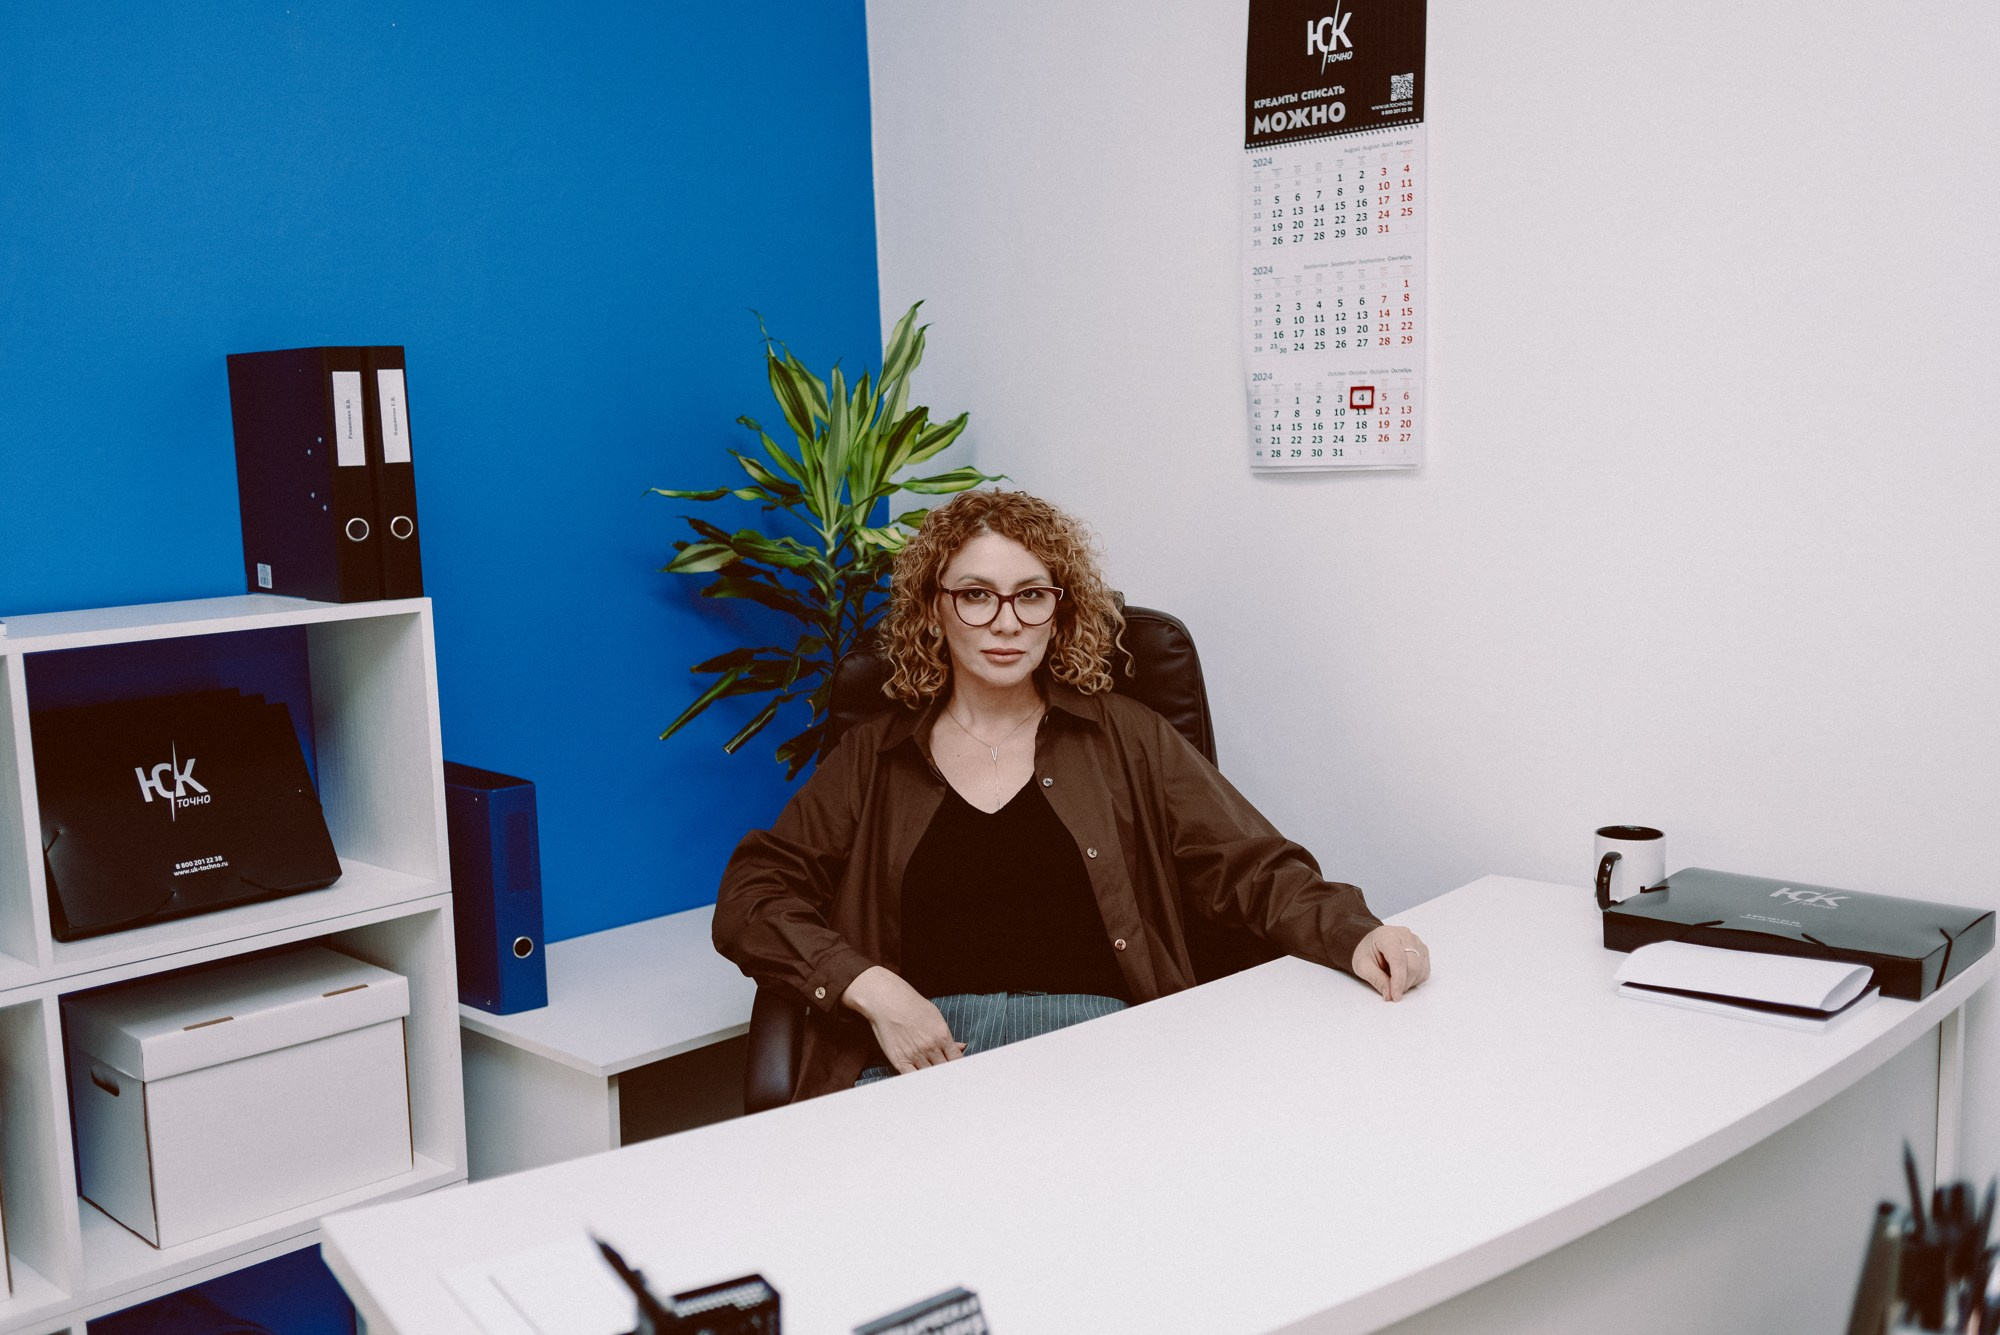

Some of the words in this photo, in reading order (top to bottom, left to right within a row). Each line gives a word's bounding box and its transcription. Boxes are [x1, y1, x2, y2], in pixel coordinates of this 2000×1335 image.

[1254, 93, 1298, 109] КРЕДИТЫ
[1301, 86, 1345, 101] СПИСАТЬ
[1253, 102, 1346, 135] МОЖНО
[1253, 158, 1273, 168] 2024
[1338, 174, 1342, 182] 1
[1360, 170, 1364, 179] 2
[1381, 168, 1386, 176] 3
[1404, 164, 1410, 172] 4
[1275, 196, 1280, 204] 5
[1295, 193, 1300, 201] 6
[1316, 190, 1322, 198] 7
[1337, 188, 1342, 196] 8
[1359, 185, 1364, 193] 9
[1378, 182, 1390, 190] 10
[1402, 179, 1412, 188] 11
[1272, 209, 1282, 218] 12
[1293, 207, 1303, 215] 13
[1314, 204, 1324, 213] 14
[1336, 201, 1346, 210] 15
[1357, 198, 1367, 208] 16
[1379, 196, 1390, 205] 17
[1402, 193, 1412, 202] 18
[1272, 223, 1282, 231] 19
[1293, 220, 1304, 229] 20
[1314, 218, 1324, 226] 21
[1335, 215, 1346, 224] 22
[1356, 213, 1367, 222] 23
[1378, 210, 1390, 219] 24
[1401, 208, 1412, 216] 25
[1272, 236, 1283, 245] 26
[1293, 234, 1304, 242] 27
[1314, 232, 1324, 240] 28
[1335, 229, 1346, 238] 29
[1356, 227, 1367, 236] 30
[1378, 224, 1389, 233] 31
[1253, 266, 1273, 275] 2024
[1404, 280, 1408, 288] 1
[1276, 304, 1280, 312] 2
[1338, 299, 1343, 307] 5
[1360, 297, 1365, 305] 6
[1382, 295, 1386, 303] 7
[1404, 294, 1409, 302] 8
[1276, 318, 1281, 326] 9
[1294, 316, 1304, 324] 10
[1336, 313, 1346, 321] 12
[1357, 311, 1368, 319] 13
[1379, 309, 1390, 318] 14
[1402, 308, 1412, 316] 15
[1274, 331, 1284, 339] 16
[1294, 330, 1304, 338] 17
[1315, 328, 1325, 336] 18
[1336, 326, 1346, 334] 19
[1357, 325, 1368, 333] 20
[1379, 324, 1389, 332] 21
[1401, 322, 1412, 330] 22
[1294, 343, 1304, 351] 24
[1315, 342, 1325, 350] 25
[1336, 340, 1346, 348] 26
[1357, 339, 1368, 347] 27
[1379, 337, 1390, 346] 28
[1401, 336, 1412, 344] 29
[1252, 373, 1273, 382] 2024
[1316, 396, 1321, 404] 2
[1338, 395, 1342, 403] 3
[1359, 394, 1364, 402] 4
[1382, 393, 1387, 401] 5
[1404, 392, 1409, 400] 6
[1274, 410, 1279, 418] 7
[1294, 410, 1300, 418] 8
[1316, 409, 1320, 417] 9
[1335, 408, 1345, 416] 10
[1379, 406, 1390, 414] 12
[1401, 406, 1412, 414] 13
[1313, 422, 1323, 430] 16
[1334, 422, 1344, 430] 17
[1356, 421, 1367, 429] 18
[1379, 420, 1390, 428] 19
[1400, 420, 1411, 428] 20
[1291, 436, 1302, 444] 22
[1312, 436, 1322, 444] 23
[1333, 435, 1344, 443] 24
[1378, 434, 1389, 442] 26
[1400, 434, 1411, 442] 27
[1312, 449, 1322, 457] 30
[1332, 448, 1343, 456] 31
[173, 861, 228, 876] www.uk-tochno.ru
[194, 858, 205, 866] 201
